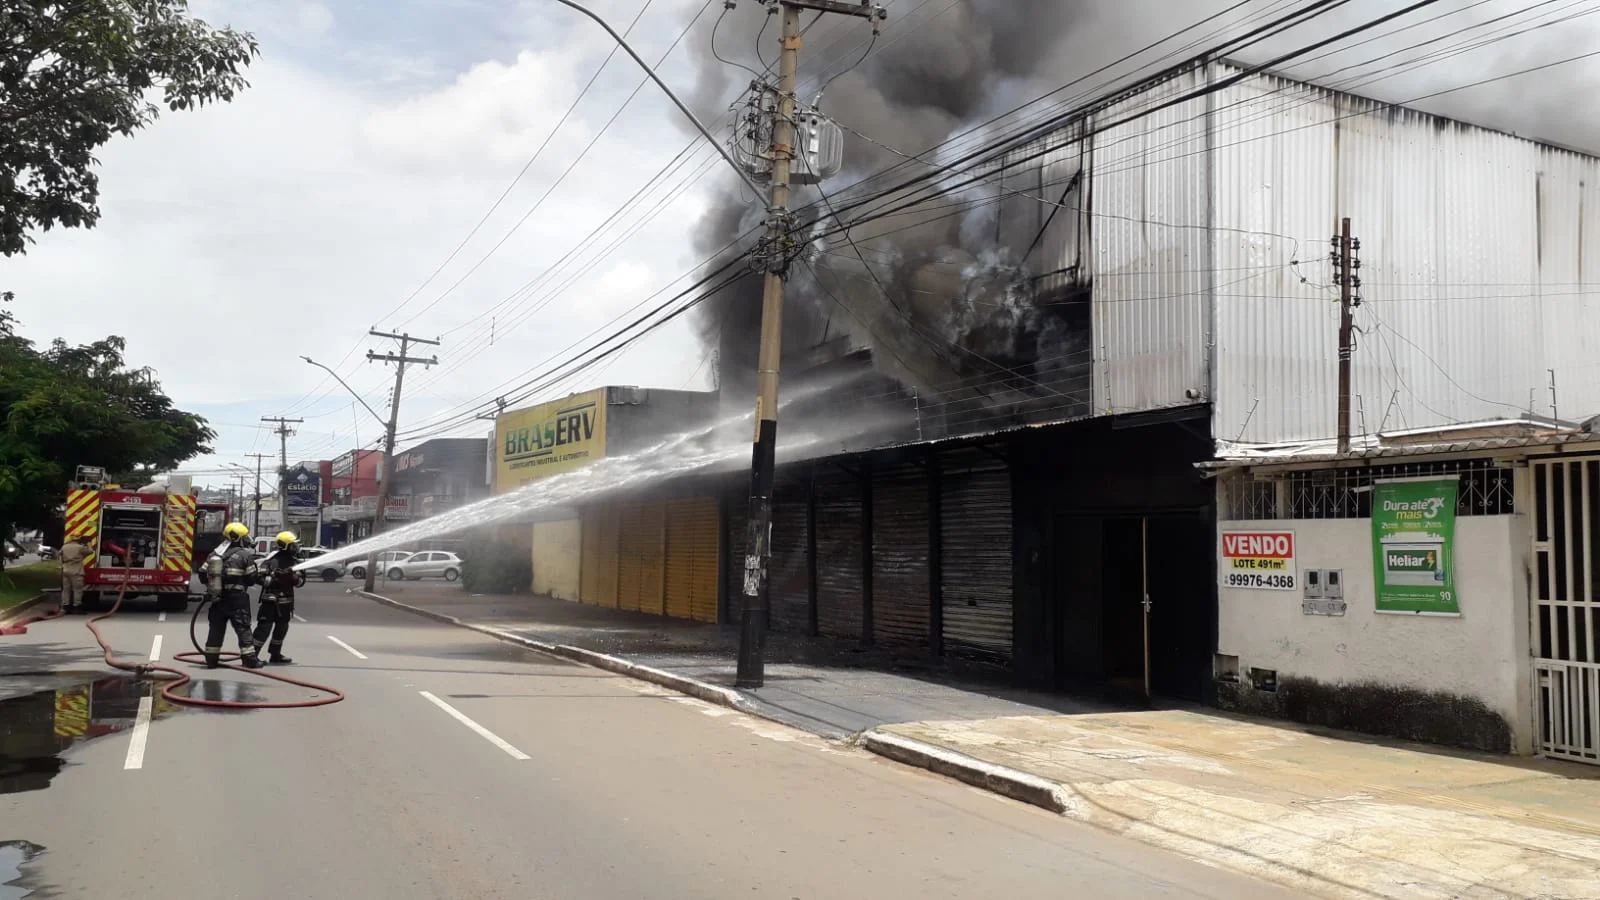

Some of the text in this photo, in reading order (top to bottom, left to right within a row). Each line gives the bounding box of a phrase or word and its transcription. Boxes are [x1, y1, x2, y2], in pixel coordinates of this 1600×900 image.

[505, 407, 597, 455] BRASERV
[1383, 500, 1409, 511] Dura
[1396, 510, 1422, 520] mais
[1224, 535, 1289, 556] VENDO
[1233, 559, 1256, 569] LOTE
[1388, 554, 1425, 567] Heliar
[1229, 573, 1294, 588] 99976-4368
[1440, 591, 1451, 601] 90
